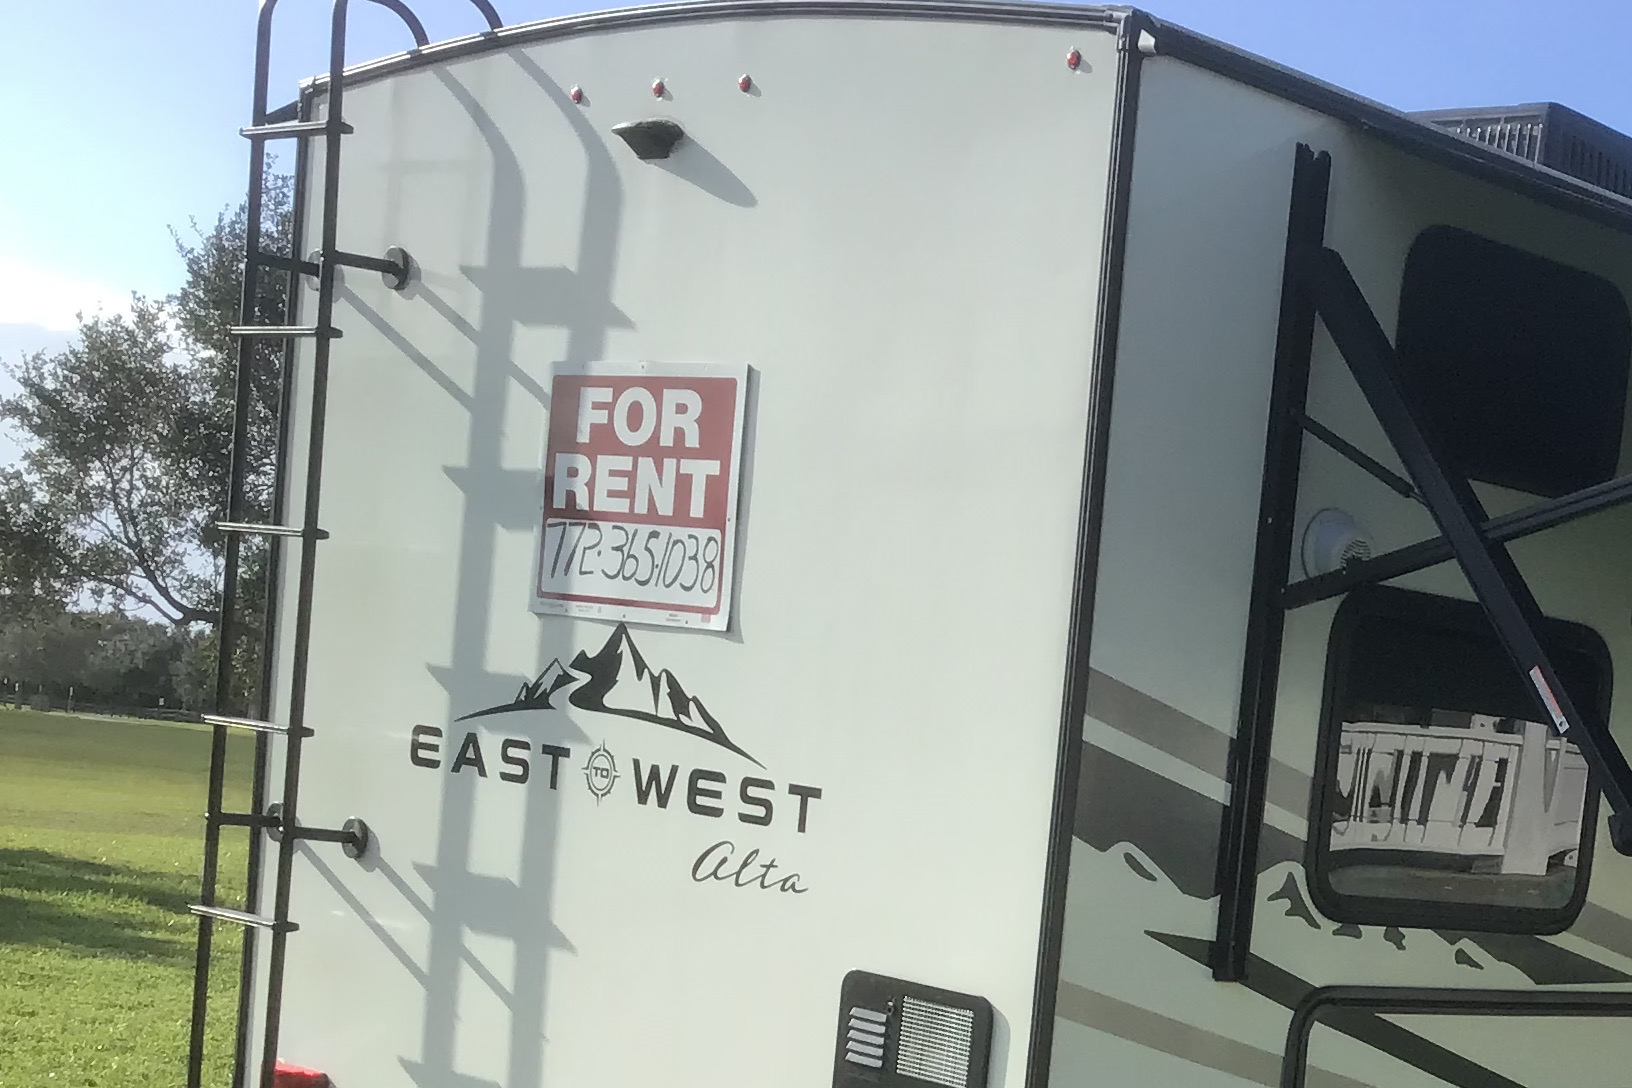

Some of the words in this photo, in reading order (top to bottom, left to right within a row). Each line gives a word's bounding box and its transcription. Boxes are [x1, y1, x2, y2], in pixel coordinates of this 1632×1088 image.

[576, 386, 702, 448] FOR
[552, 453, 720, 518] RENT
[410, 724, 571, 790] EAST
[592, 766, 610, 779] TO
[632, 757, 822, 833] WEST
